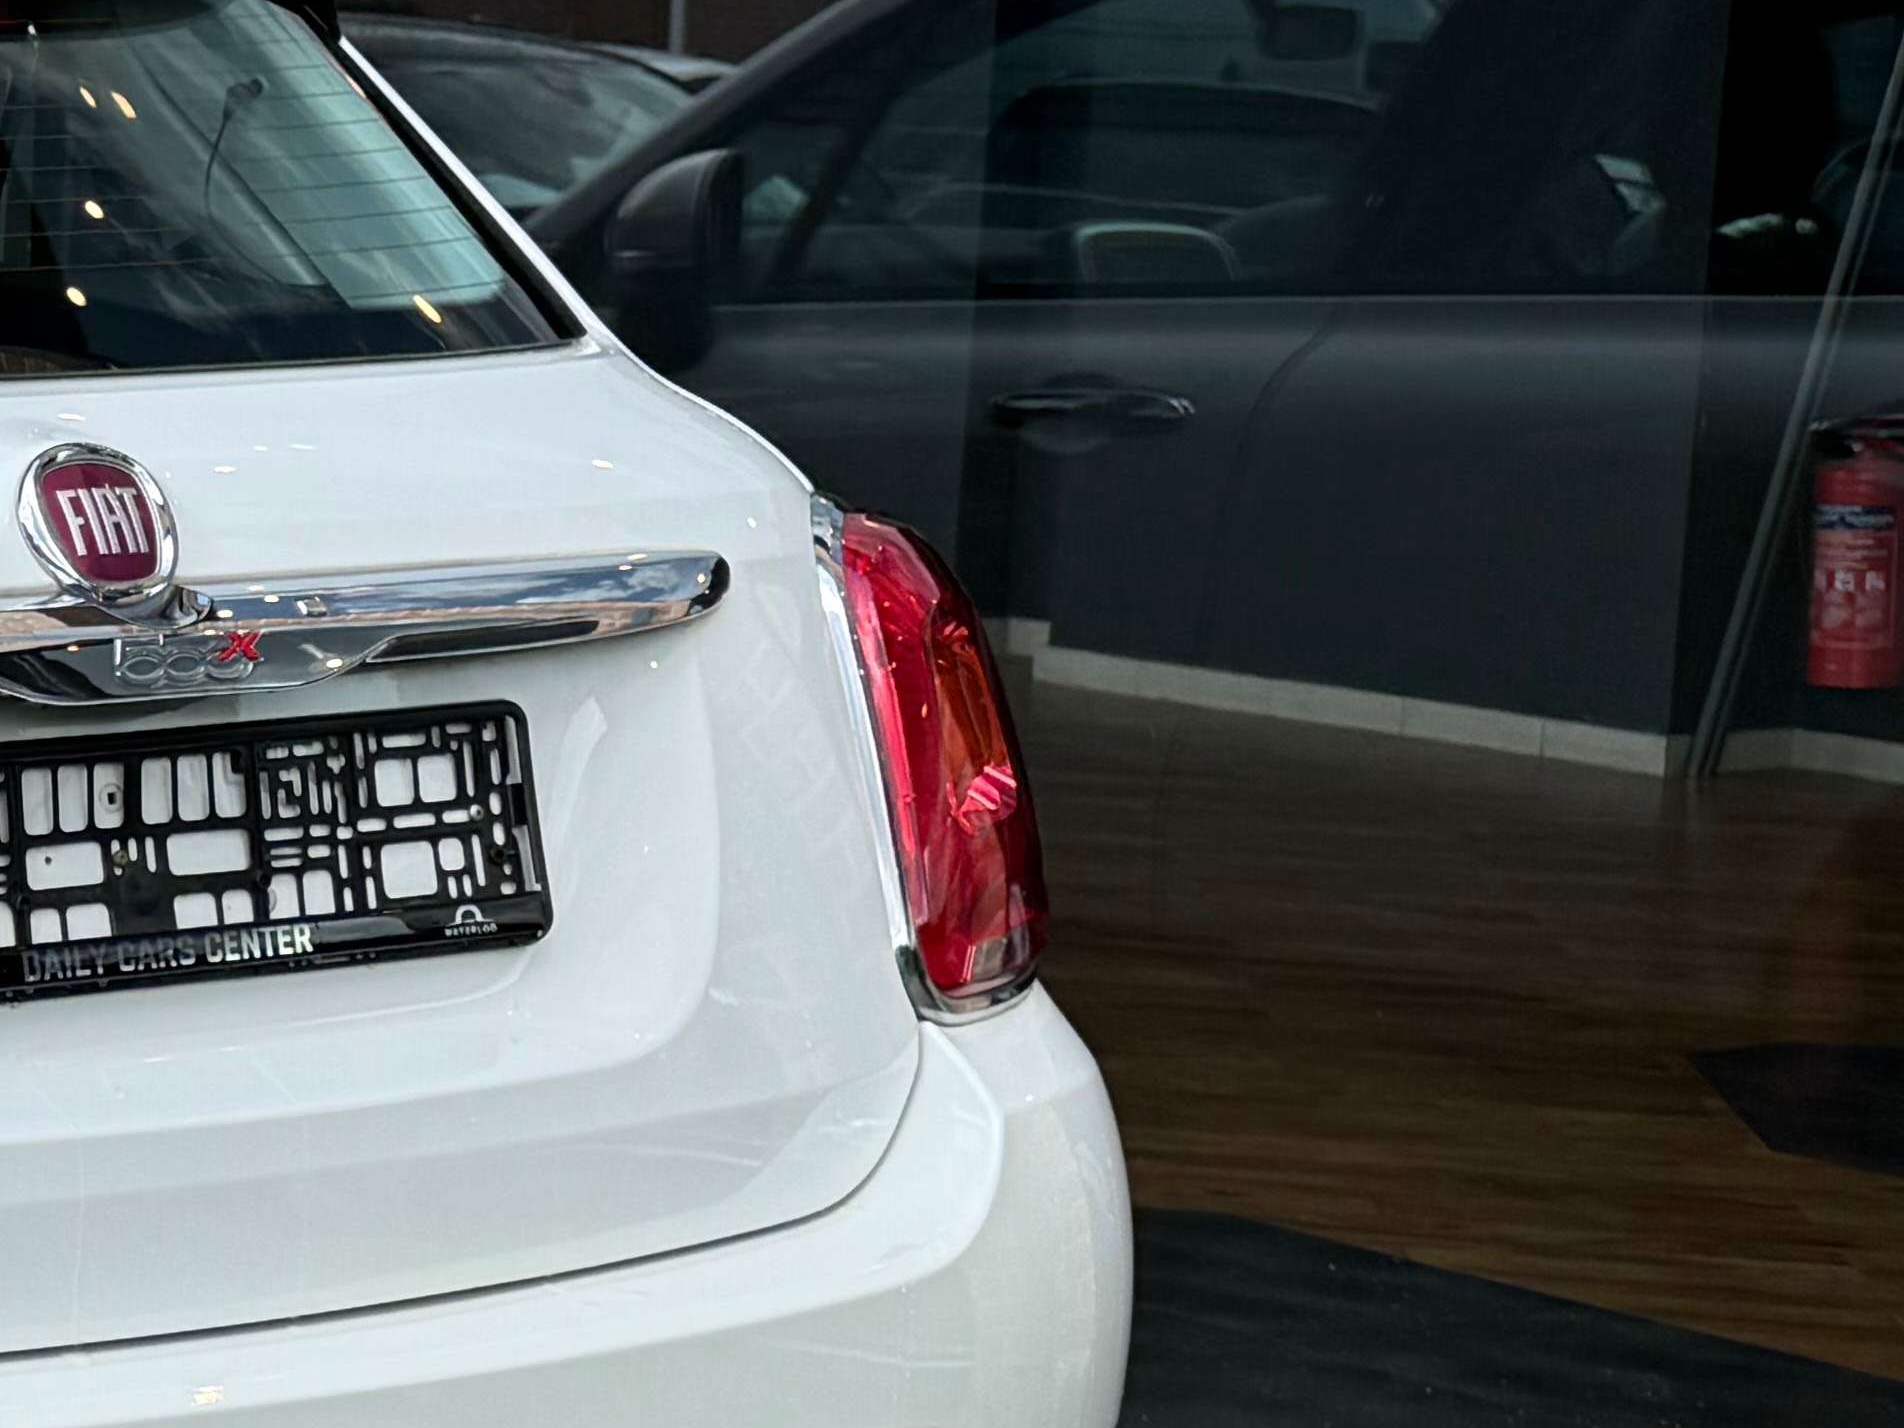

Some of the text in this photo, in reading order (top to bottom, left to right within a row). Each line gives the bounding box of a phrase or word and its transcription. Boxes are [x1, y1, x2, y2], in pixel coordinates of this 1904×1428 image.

[56, 484, 149, 557] FIAT
[21, 922, 314, 983] DAILY CARS CENTER
